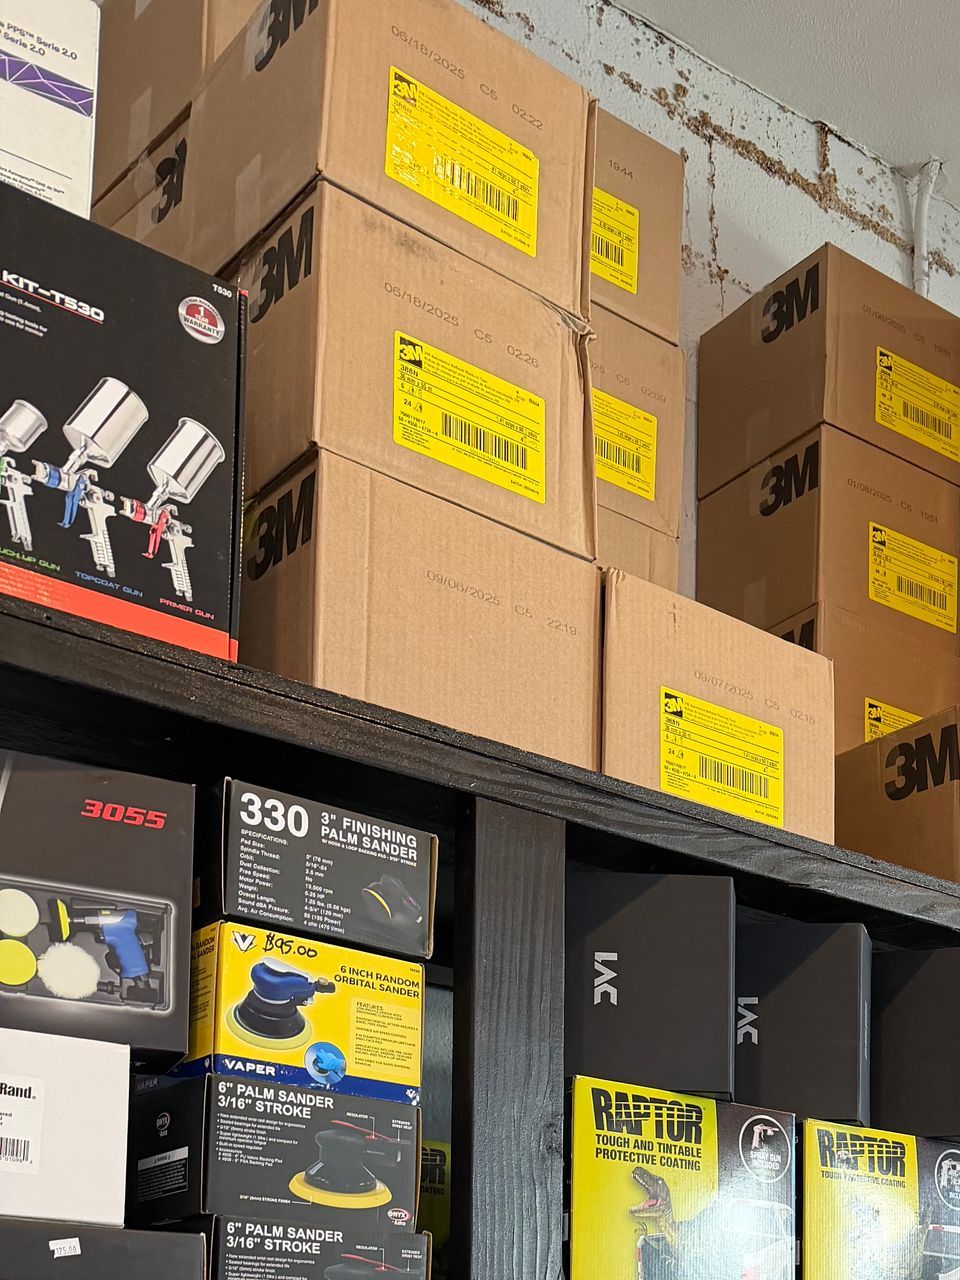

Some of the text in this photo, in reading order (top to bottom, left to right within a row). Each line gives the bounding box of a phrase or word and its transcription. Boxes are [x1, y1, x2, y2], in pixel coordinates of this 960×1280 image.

[248, 206, 314, 324] 3M
[212, 284, 233, 298] T530
[761, 262, 820, 344] 3M
[399, 344, 423, 364] 3M
[74, 570, 143, 599] TOPCOAT GUN
[159, 597, 215, 621] PRIMER GUN
[664, 697, 684, 717] 3M
[884, 723, 960, 801] 3M
[81, 799, 168, 830] 3055
[239, 792, 308, 838] 330
[320, 811, 418, 848] 3" FINISHING
[320, 825, 418, 861] PALM SANDER
[262, 931, 318, 960] $95.00
[333, 974, 420, 1000] ORBITAL SANDER
[339, 964, 420, 990] 6 INCH RANDOM
[223, 1058, 276, 1078] VAPER
[0, 1081, 33, 1100] Rand
[217, 1081, 335, 1110] 6" PALM SANDER
[217, 1094, 312, 1120] 3/16" STROKE
[590, 1087, 704, 1146] RAPTOR
[595, 1134, 702, 1160] TOUGH AND TINTABLE
[595, 1148, 701, 1172] PROTECTIVE COATING
[816, 1127, 908, 1178] RAPTOR
